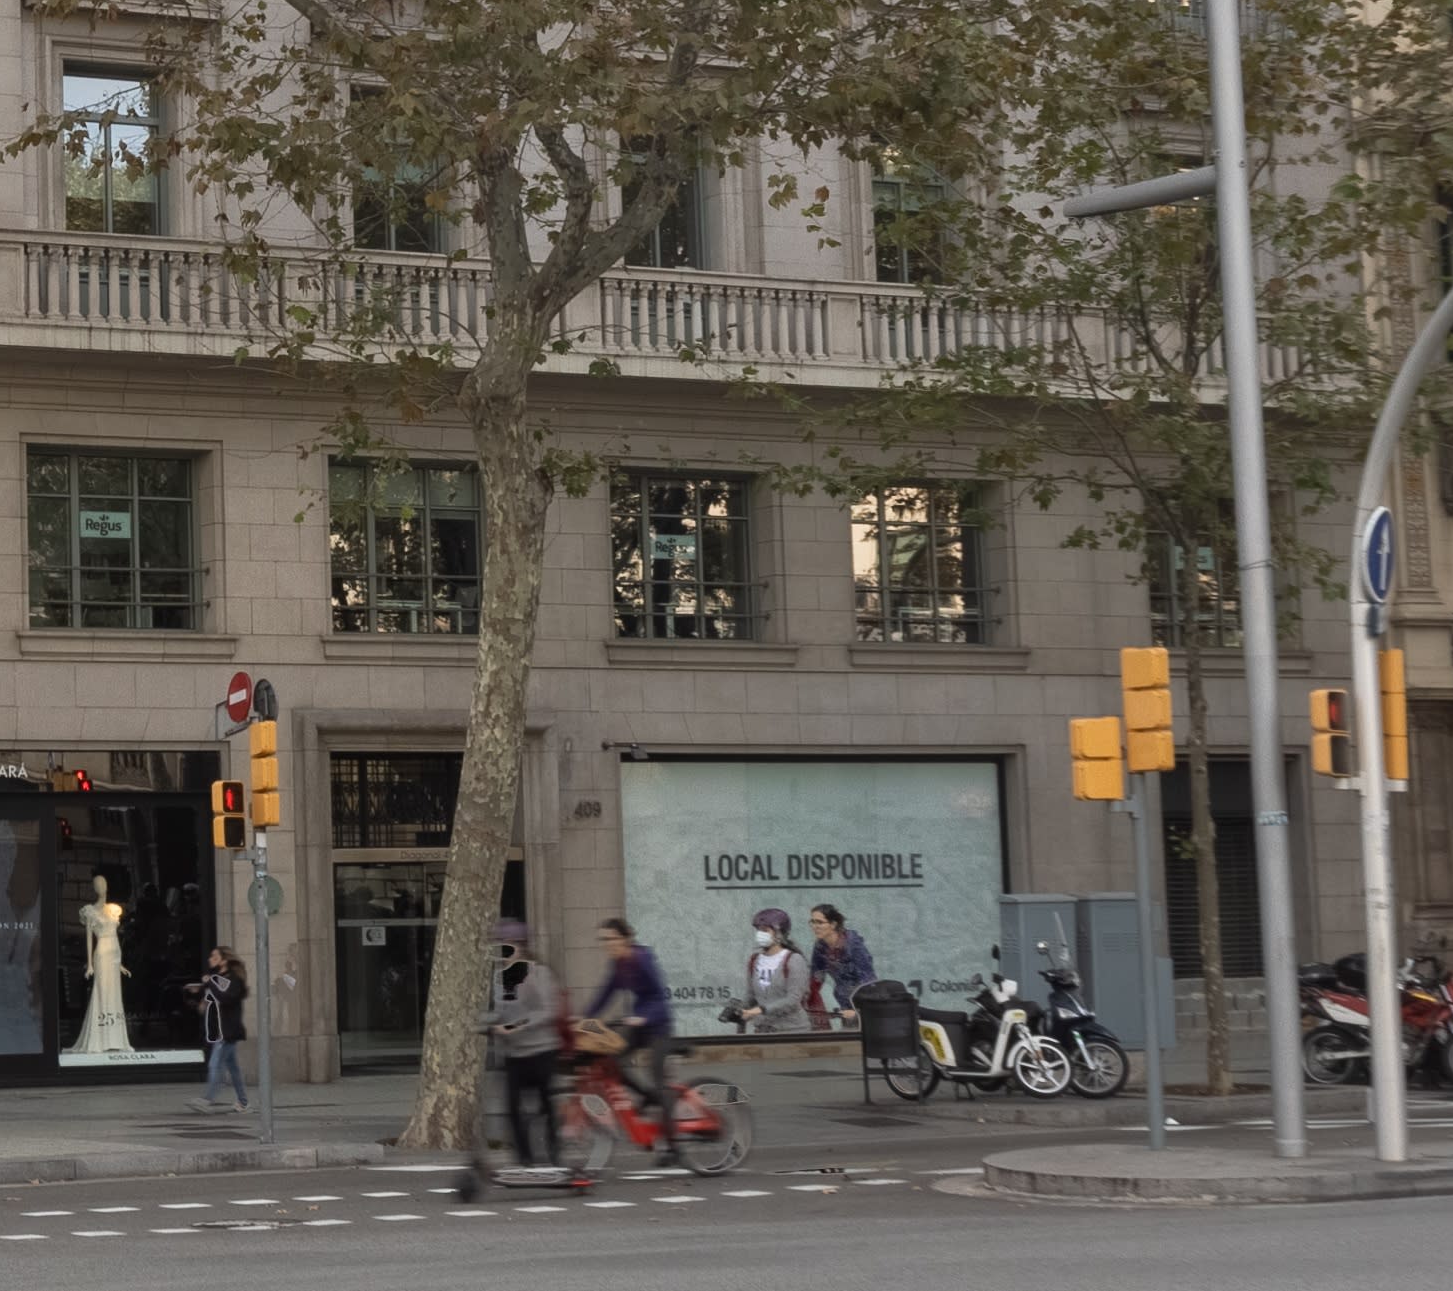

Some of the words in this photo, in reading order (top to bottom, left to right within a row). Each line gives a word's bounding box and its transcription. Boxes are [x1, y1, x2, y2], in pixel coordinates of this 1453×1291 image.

[85, 518, 122, 536] Regus
[704, 854, 780, 881] LOCAL
[787, 853, 923, 880] DISPONIBLE
[14, 922, 34, 930] 2021
[674, 987, 696, 999] 404
[698, 986, 714, 999] 78
[717, 985, 731, 998] 15
